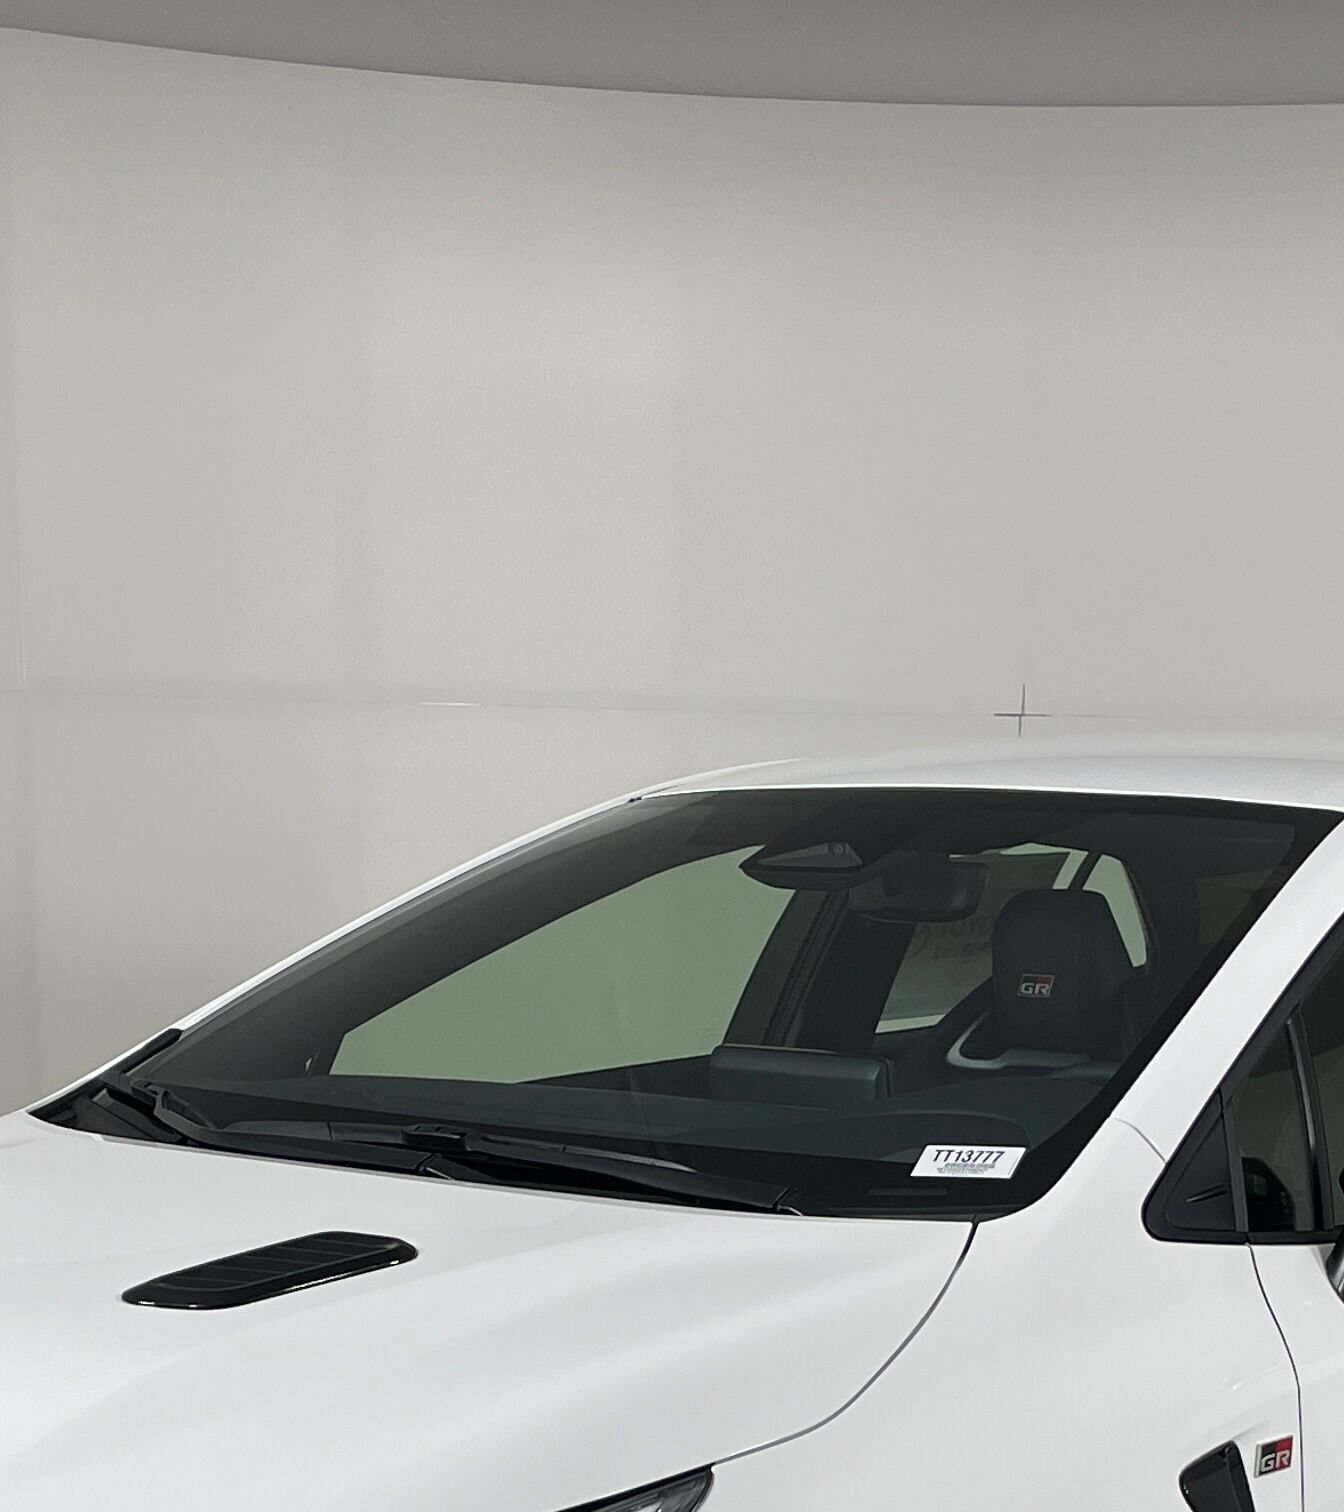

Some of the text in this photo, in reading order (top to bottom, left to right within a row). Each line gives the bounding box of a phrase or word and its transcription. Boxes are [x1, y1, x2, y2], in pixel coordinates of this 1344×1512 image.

[1021, 982, 1050, 995] GR
[933, 1149, 1005, 1163] TT13777
[1260, 1449, 1290, 1472] GR
